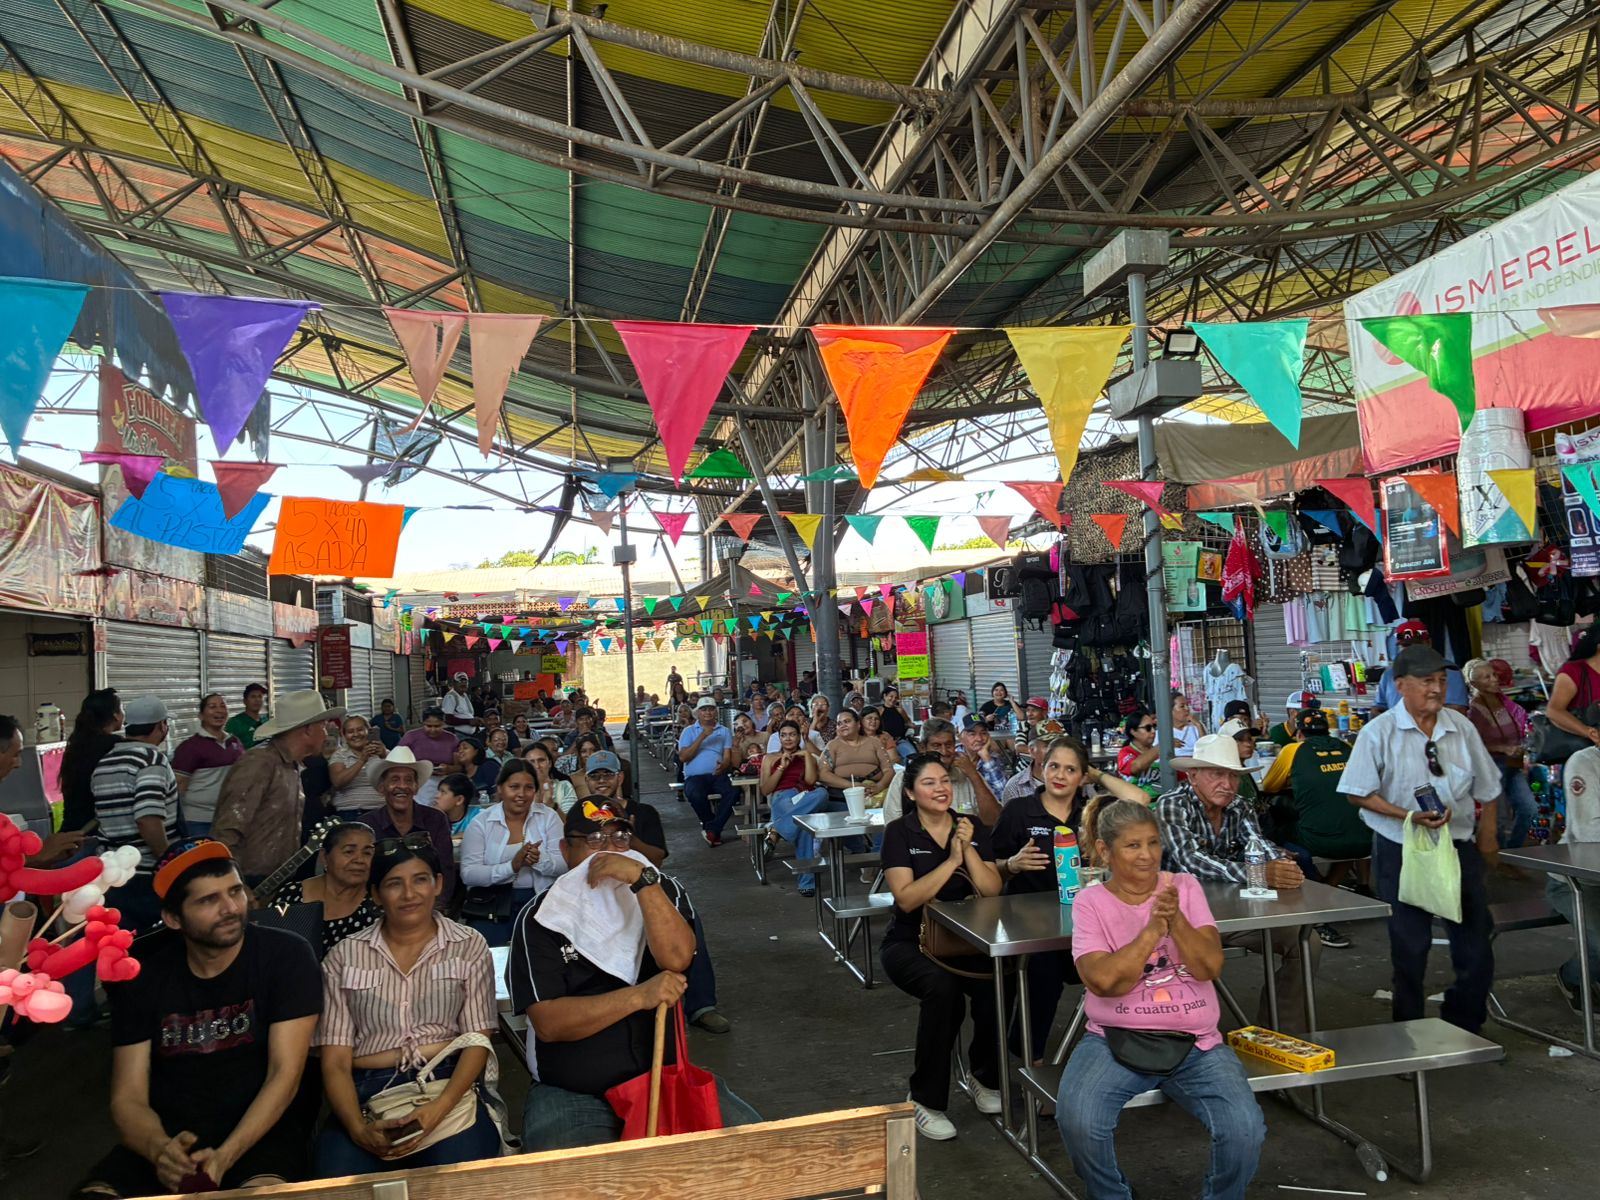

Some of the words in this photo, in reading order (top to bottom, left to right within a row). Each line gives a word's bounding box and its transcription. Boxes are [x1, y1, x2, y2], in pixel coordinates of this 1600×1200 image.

[141, 476, 188, 510] 5
[190, 483, 217, 495] TACO
[115, 502, 149, 535] AL
[157, 511, 249, 551] PASTOR
[283, 500, 319, 538] 5
[323, 501, 361, 518] TACOS
[344, 517, 368, 546] 40
[283, 540, 368, 572] ASADA
[1115, 1002, 1130, 1014] de
[1134, 1004, 1180, 1015] cuatro
[162, 1012, 250, 1047] HUGO
[1264, 1049, 1287, 1064] Rosa
